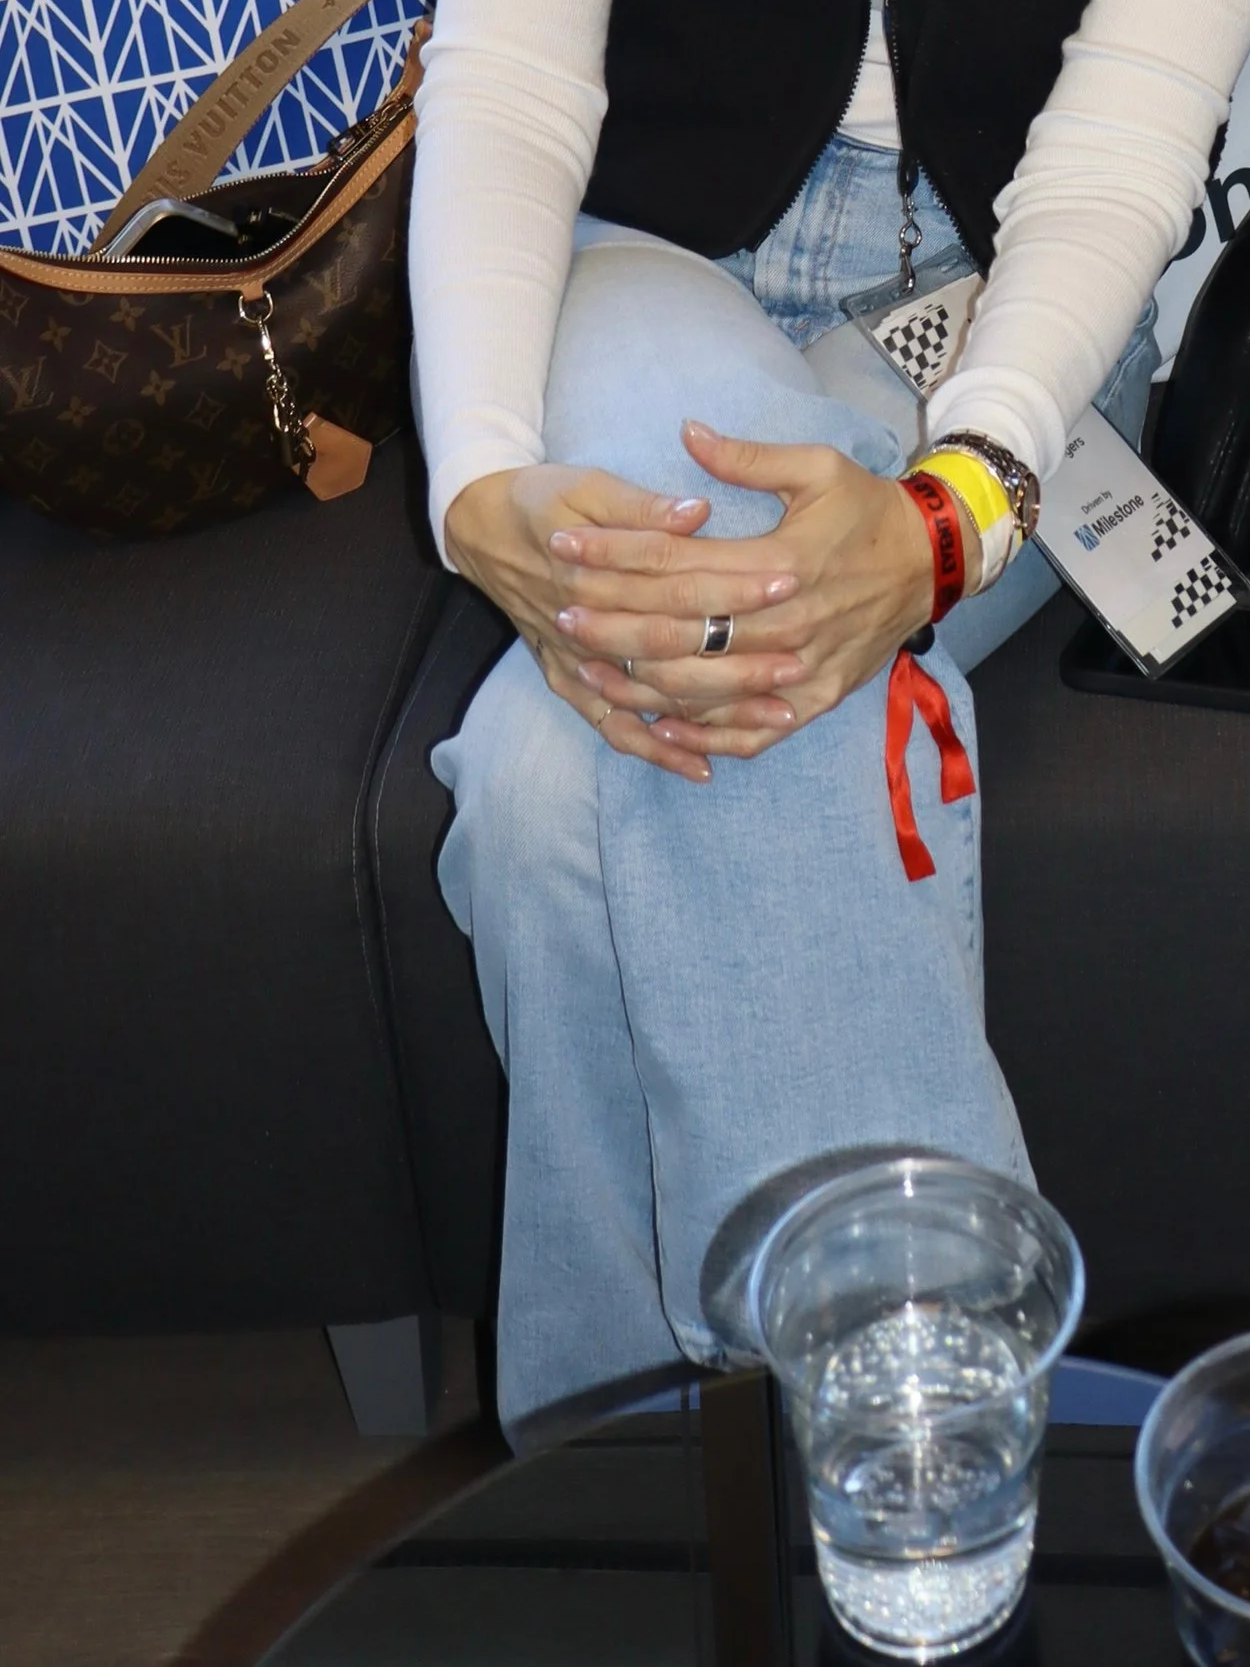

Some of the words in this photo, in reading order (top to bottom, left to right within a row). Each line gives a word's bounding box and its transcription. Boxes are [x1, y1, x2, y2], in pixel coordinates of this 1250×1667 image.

[183, 28, 301, 158] VUITTON
[1081, 495, 1104, 514] Driven
[1091, 495, 1144, 538] Milestone
